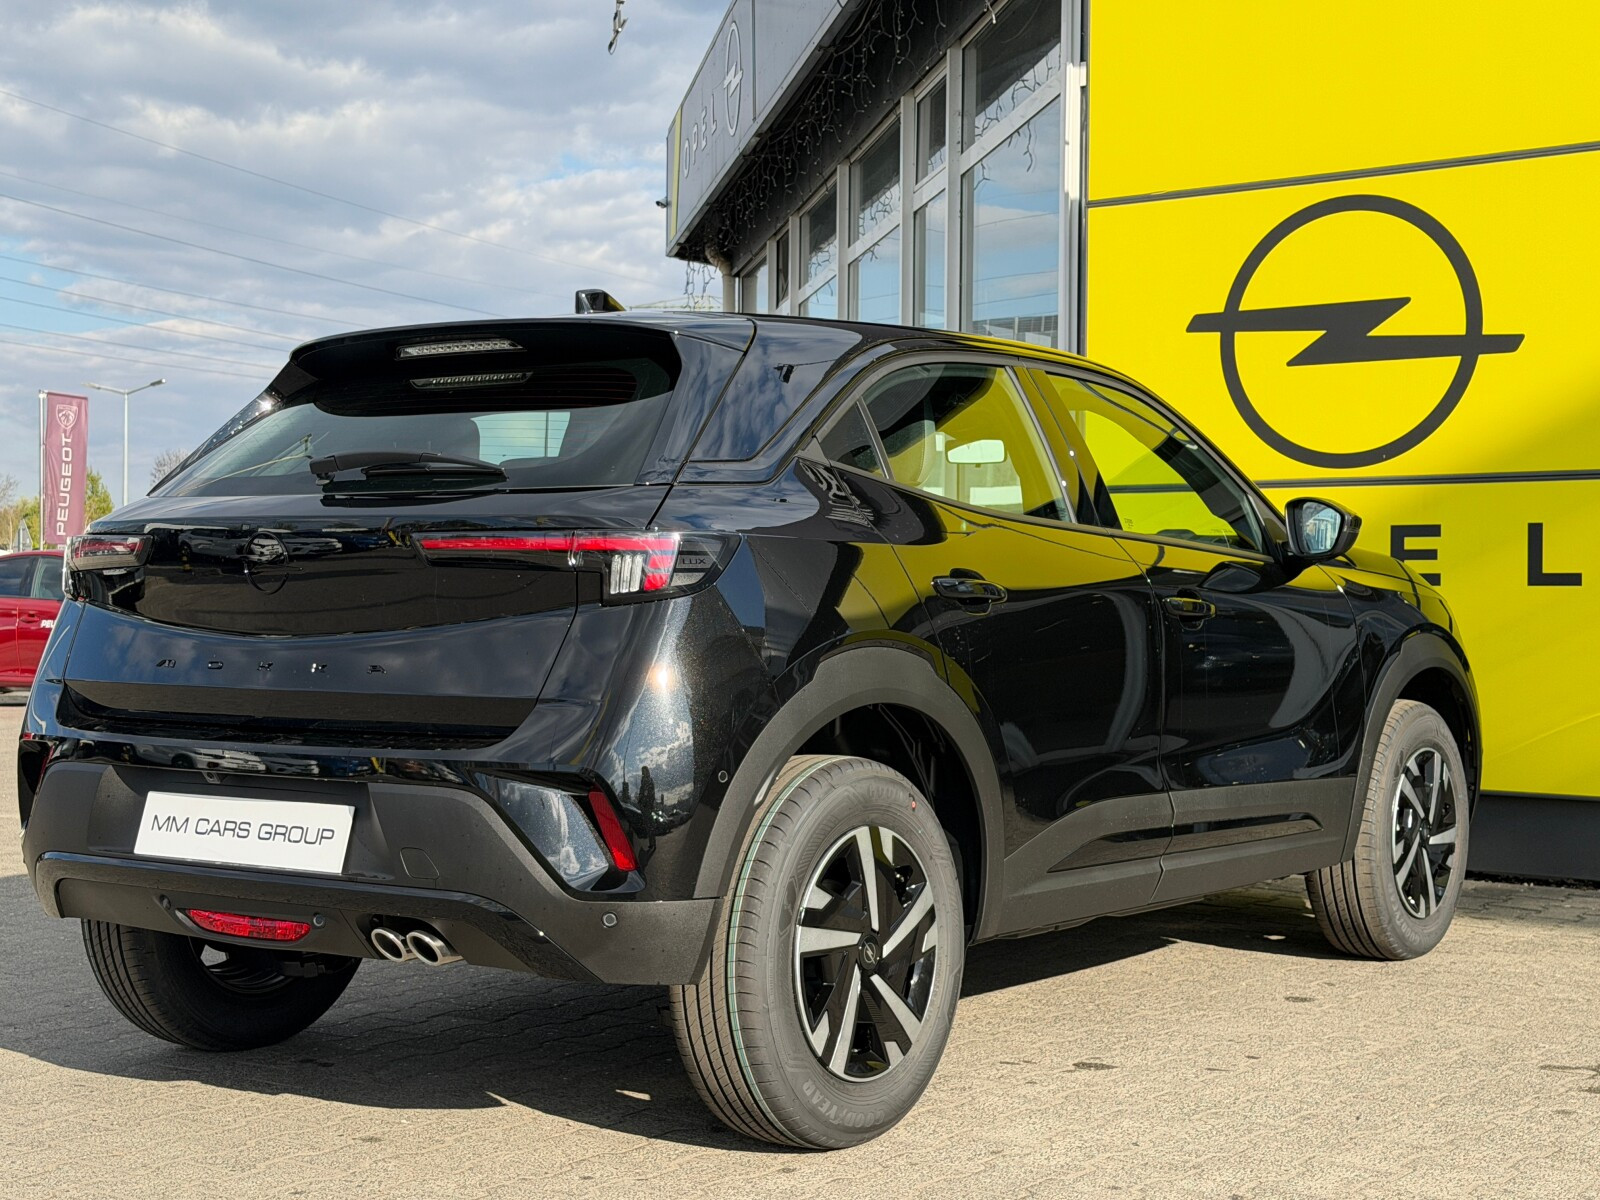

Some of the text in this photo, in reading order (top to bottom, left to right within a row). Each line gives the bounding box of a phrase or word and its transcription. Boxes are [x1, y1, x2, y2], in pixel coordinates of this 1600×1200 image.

[683, 93, 718, 179] OPEL
[56, 432, 73, 536] PEUGEOT
[682, 557, 707, 565] LUX
[151, 814, 335, 846] MM CARS GROUP
